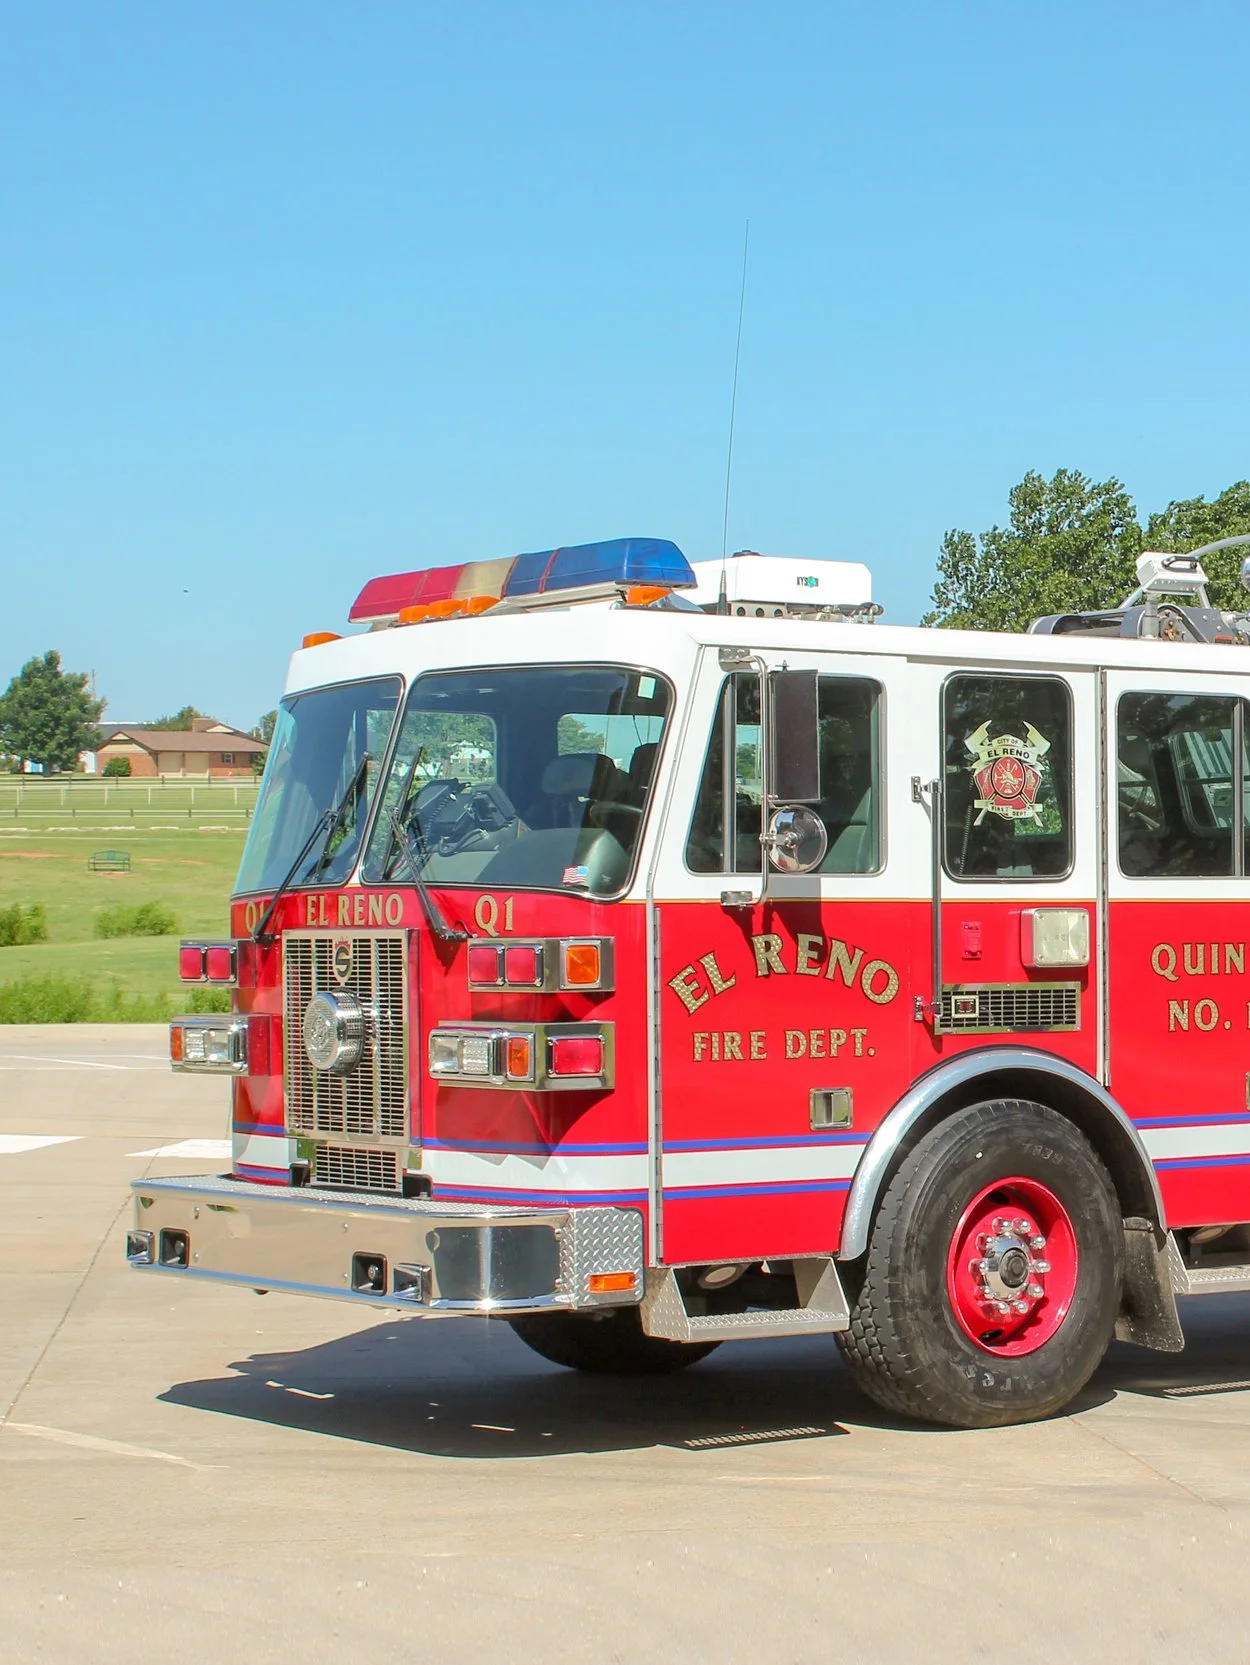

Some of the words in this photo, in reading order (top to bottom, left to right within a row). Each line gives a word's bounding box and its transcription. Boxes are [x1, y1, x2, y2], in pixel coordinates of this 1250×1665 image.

[987, 750, 999, 758] EL
[1002, 748, 1030, 759] RENO
[306, 895, 329, 926] EL
[337, 893, 404, 926] RENO
[474, 894, 514, 937] Q1
[667, 951, 737, 1016] EL
[751, 933, 900, 1005] RENO
[1168, 998, 1232, 1032] NO.
[692, 1031, 767, 1062] FIRE
[784, 1028, 877, 1059] DEPT.
